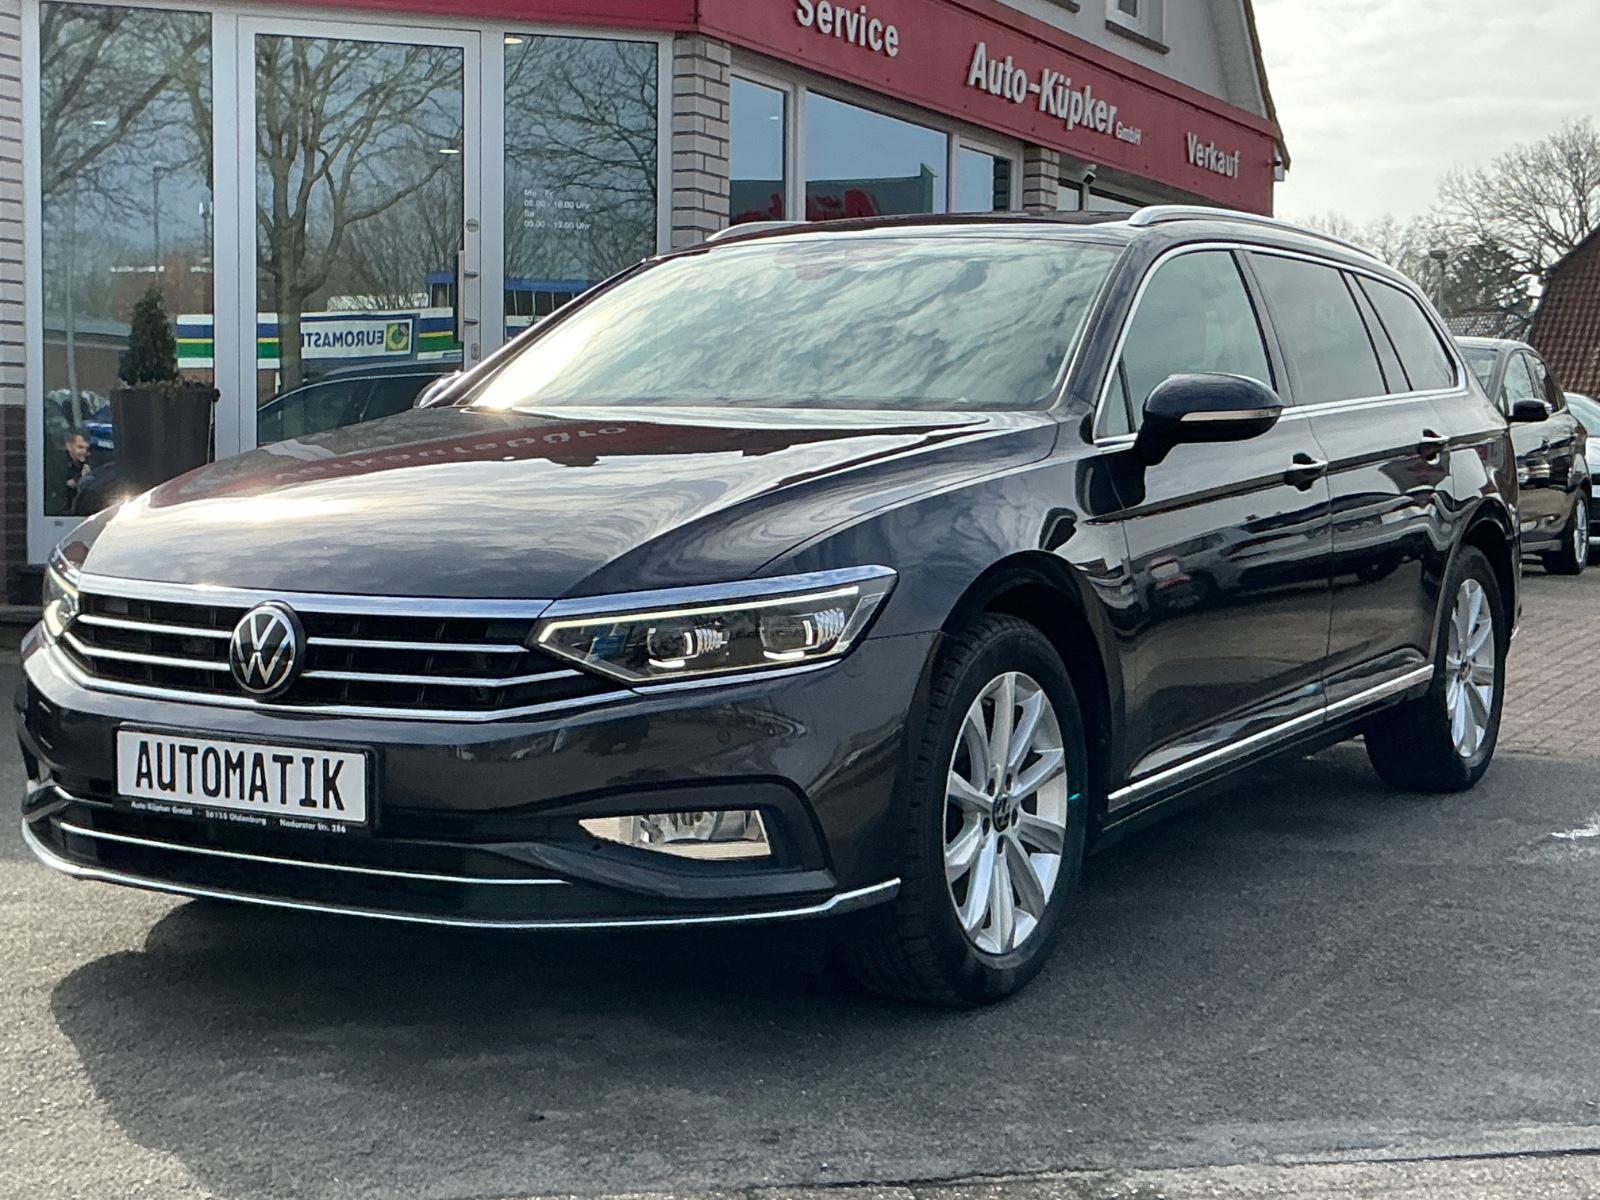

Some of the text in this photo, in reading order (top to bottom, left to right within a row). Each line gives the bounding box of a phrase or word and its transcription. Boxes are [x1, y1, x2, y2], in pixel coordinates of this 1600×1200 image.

[797, 0, 899, 57] Service
[968, 42, 1142, 146] Auto-Küpker GmbH
[1187, 131, 1240, 179] Verkauf
[135, 740, 346, 812] AUTOMATIK
